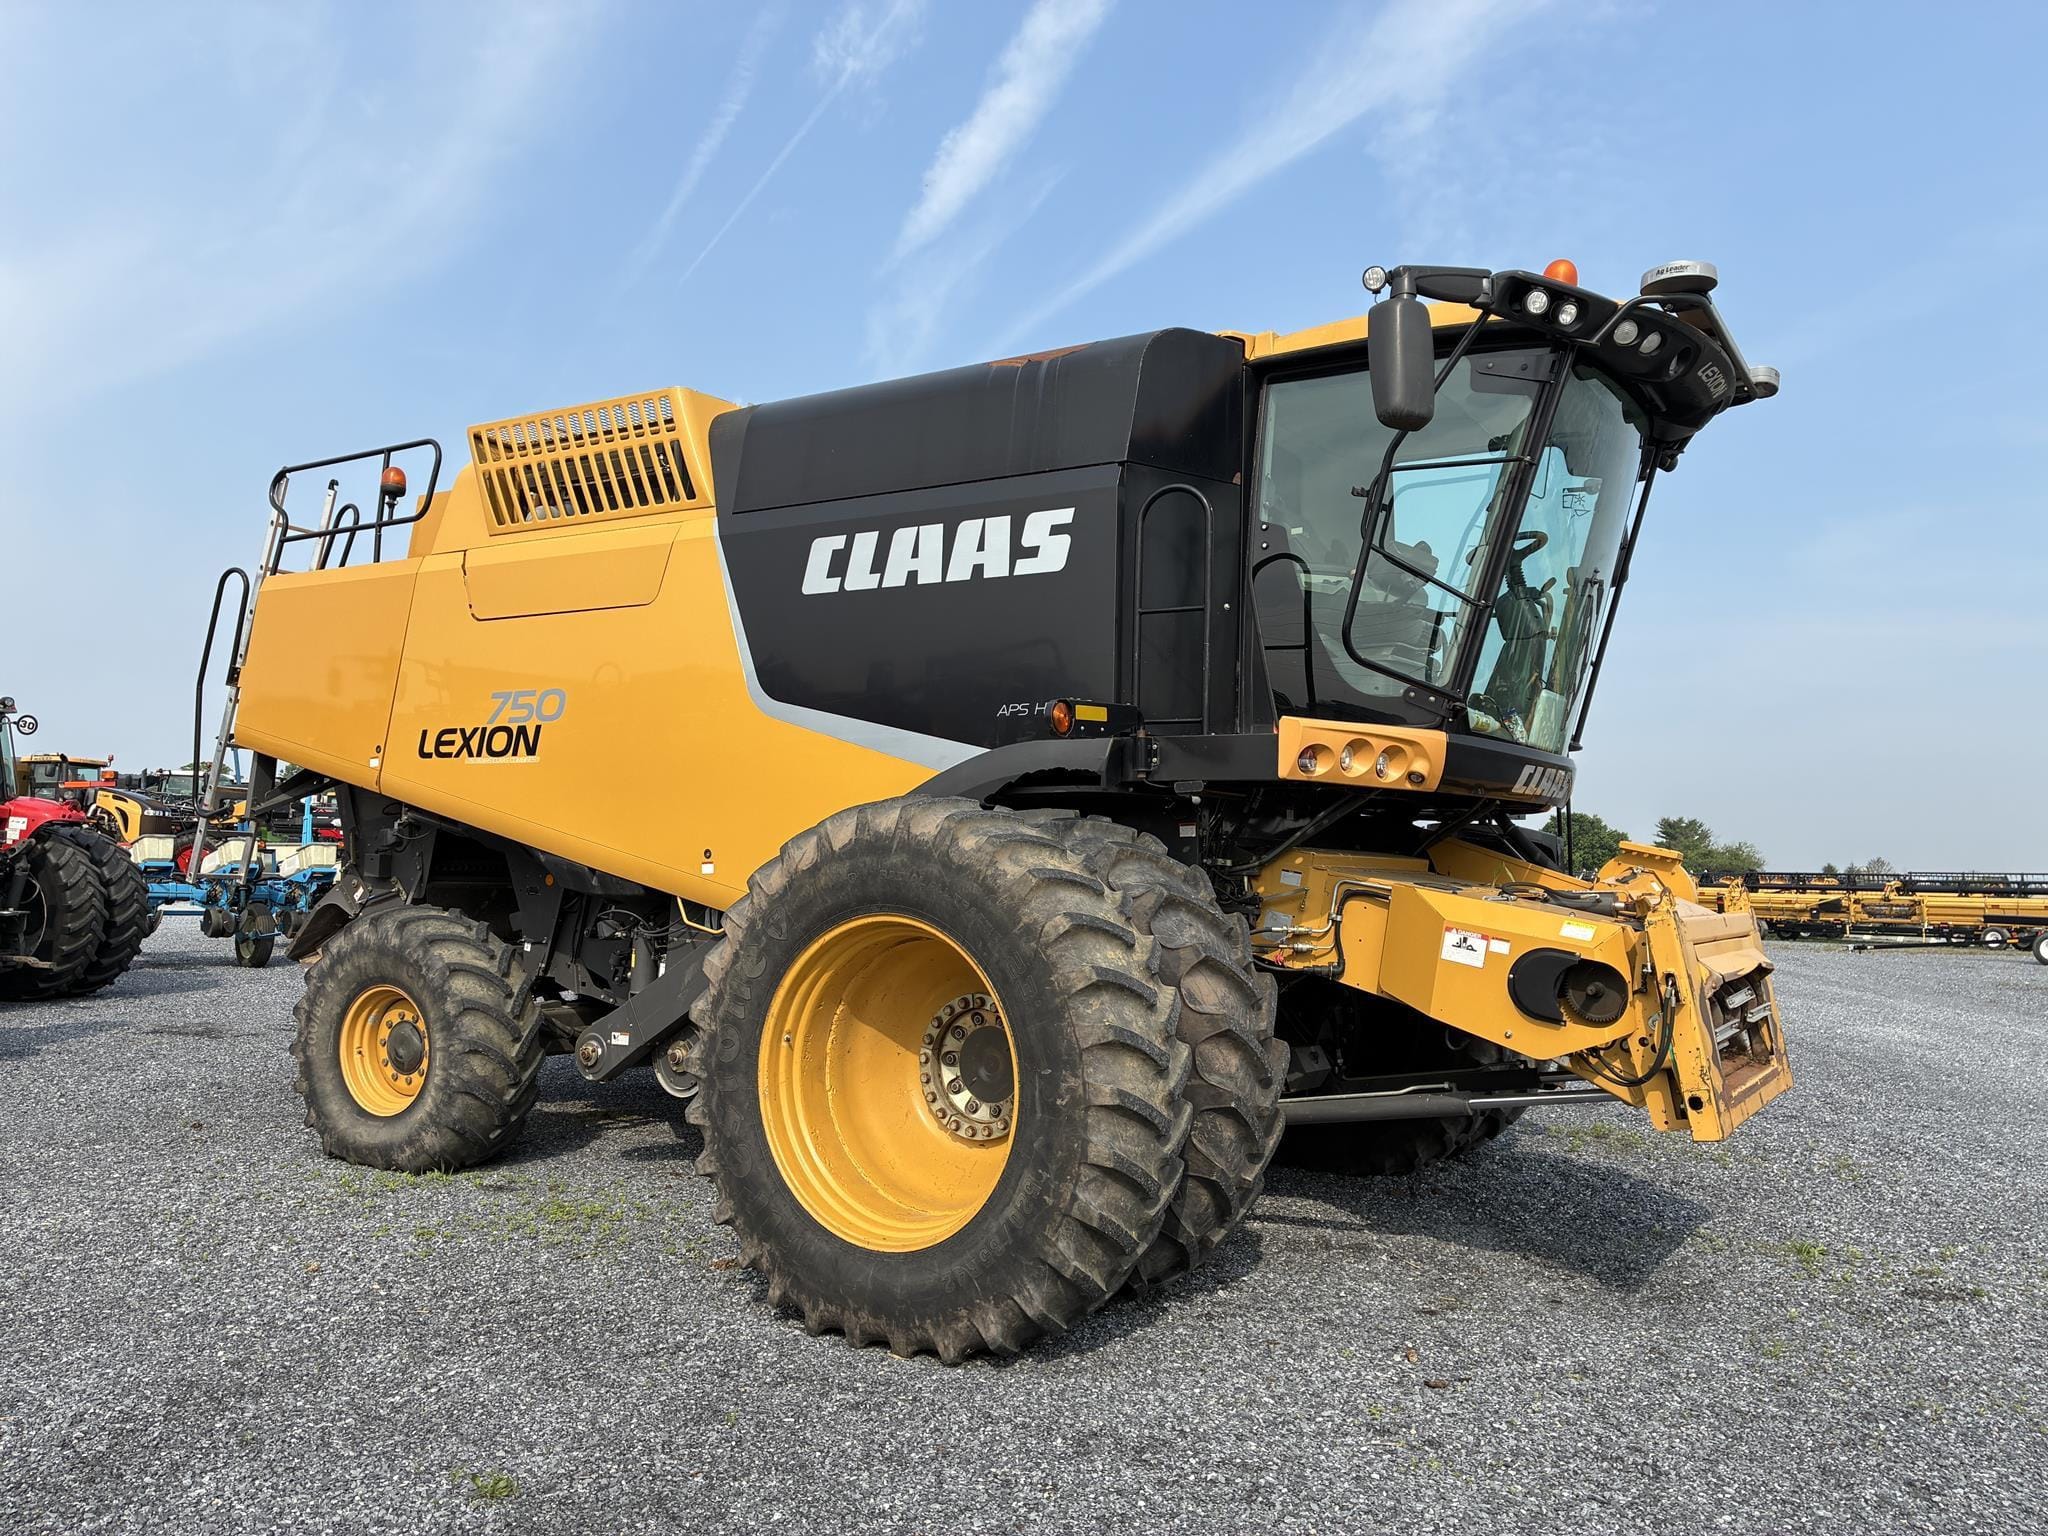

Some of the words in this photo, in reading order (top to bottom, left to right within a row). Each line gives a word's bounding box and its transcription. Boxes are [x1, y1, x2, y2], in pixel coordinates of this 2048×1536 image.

[1666, 264, 1689, 273] Leader
[1697, 361, 1728, 399] LEXION
[801, 507, 1076, 596] CLAAS
[486, 688, 566, 724] 750
[996, 702, 1030, 717] APS
[19, 719, 35, 731] 30
[418, 724, 542, 759] LEXION
